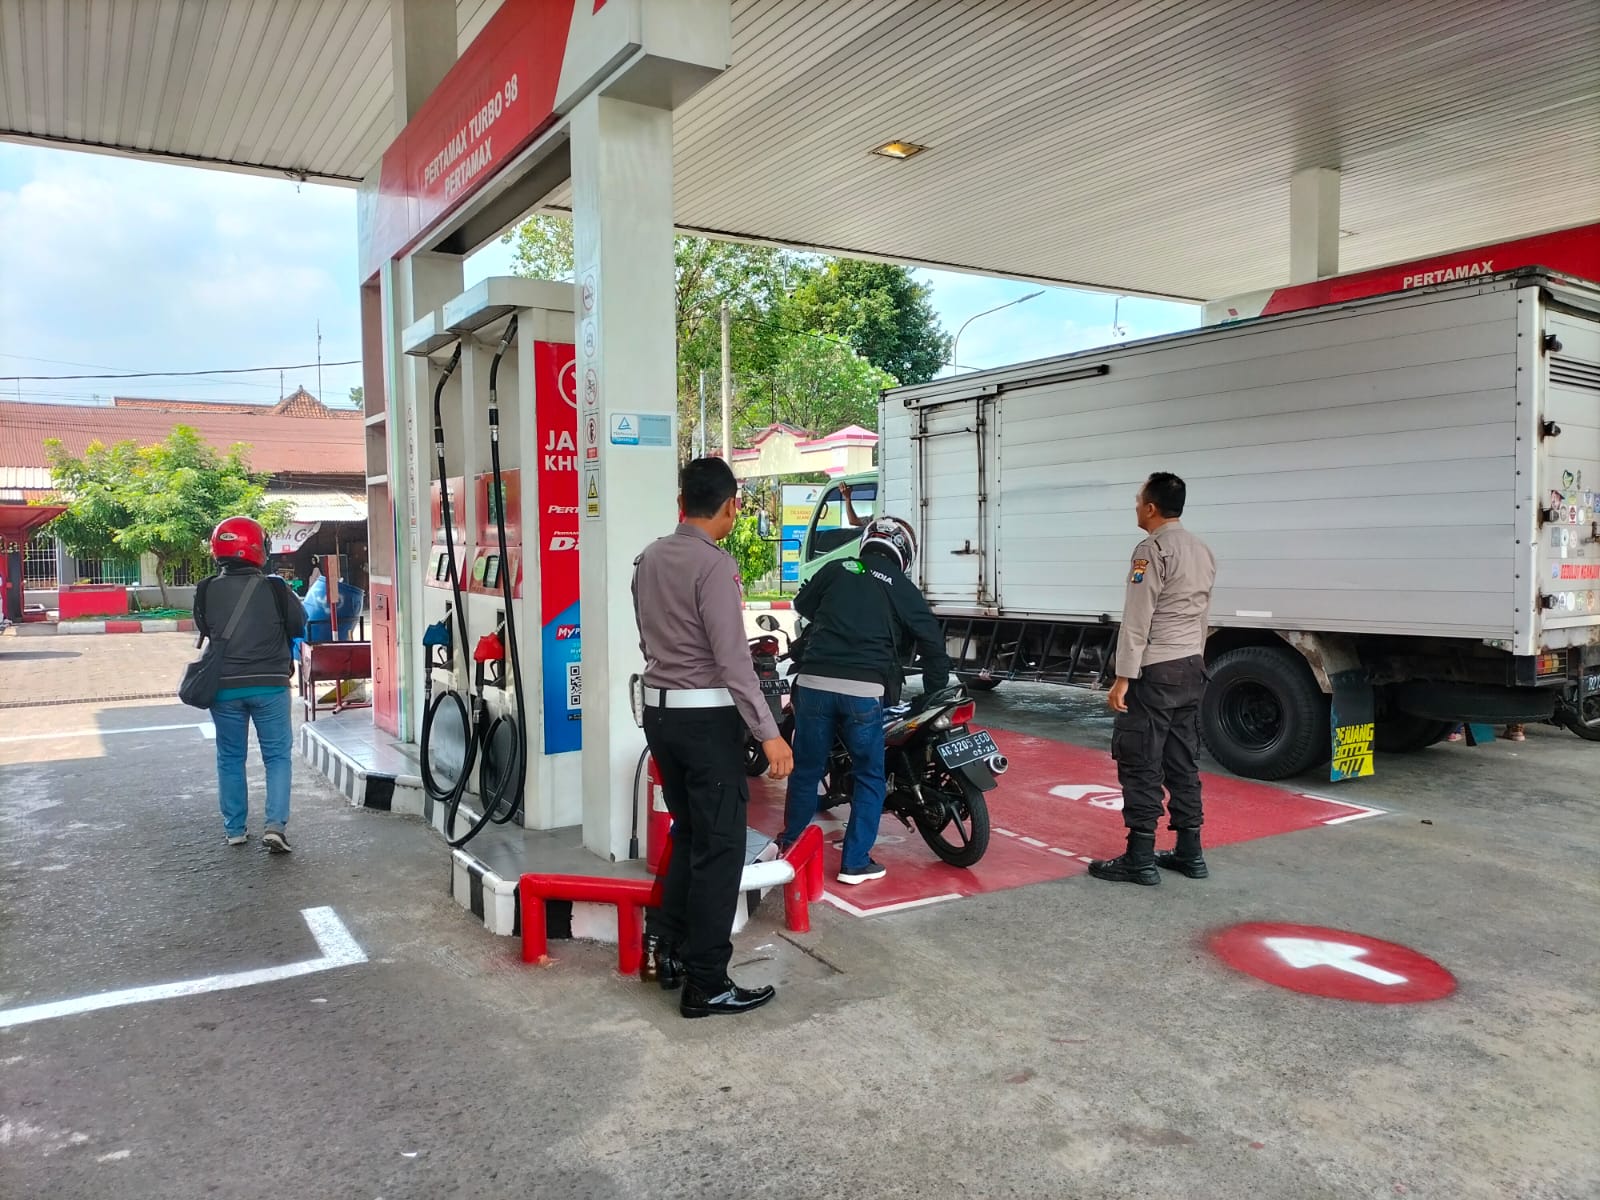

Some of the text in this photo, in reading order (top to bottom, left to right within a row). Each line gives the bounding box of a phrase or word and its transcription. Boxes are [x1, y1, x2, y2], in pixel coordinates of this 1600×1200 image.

[424, 73, 518, 189] PERTAMAX TURBO 98
[444, 136, 492, 200] PERTAMAX
[1403, 260, 1494, 289] PERTAMAX
[544, 430, 577, 451] JA
[951, 738, 974, 753] 3205
